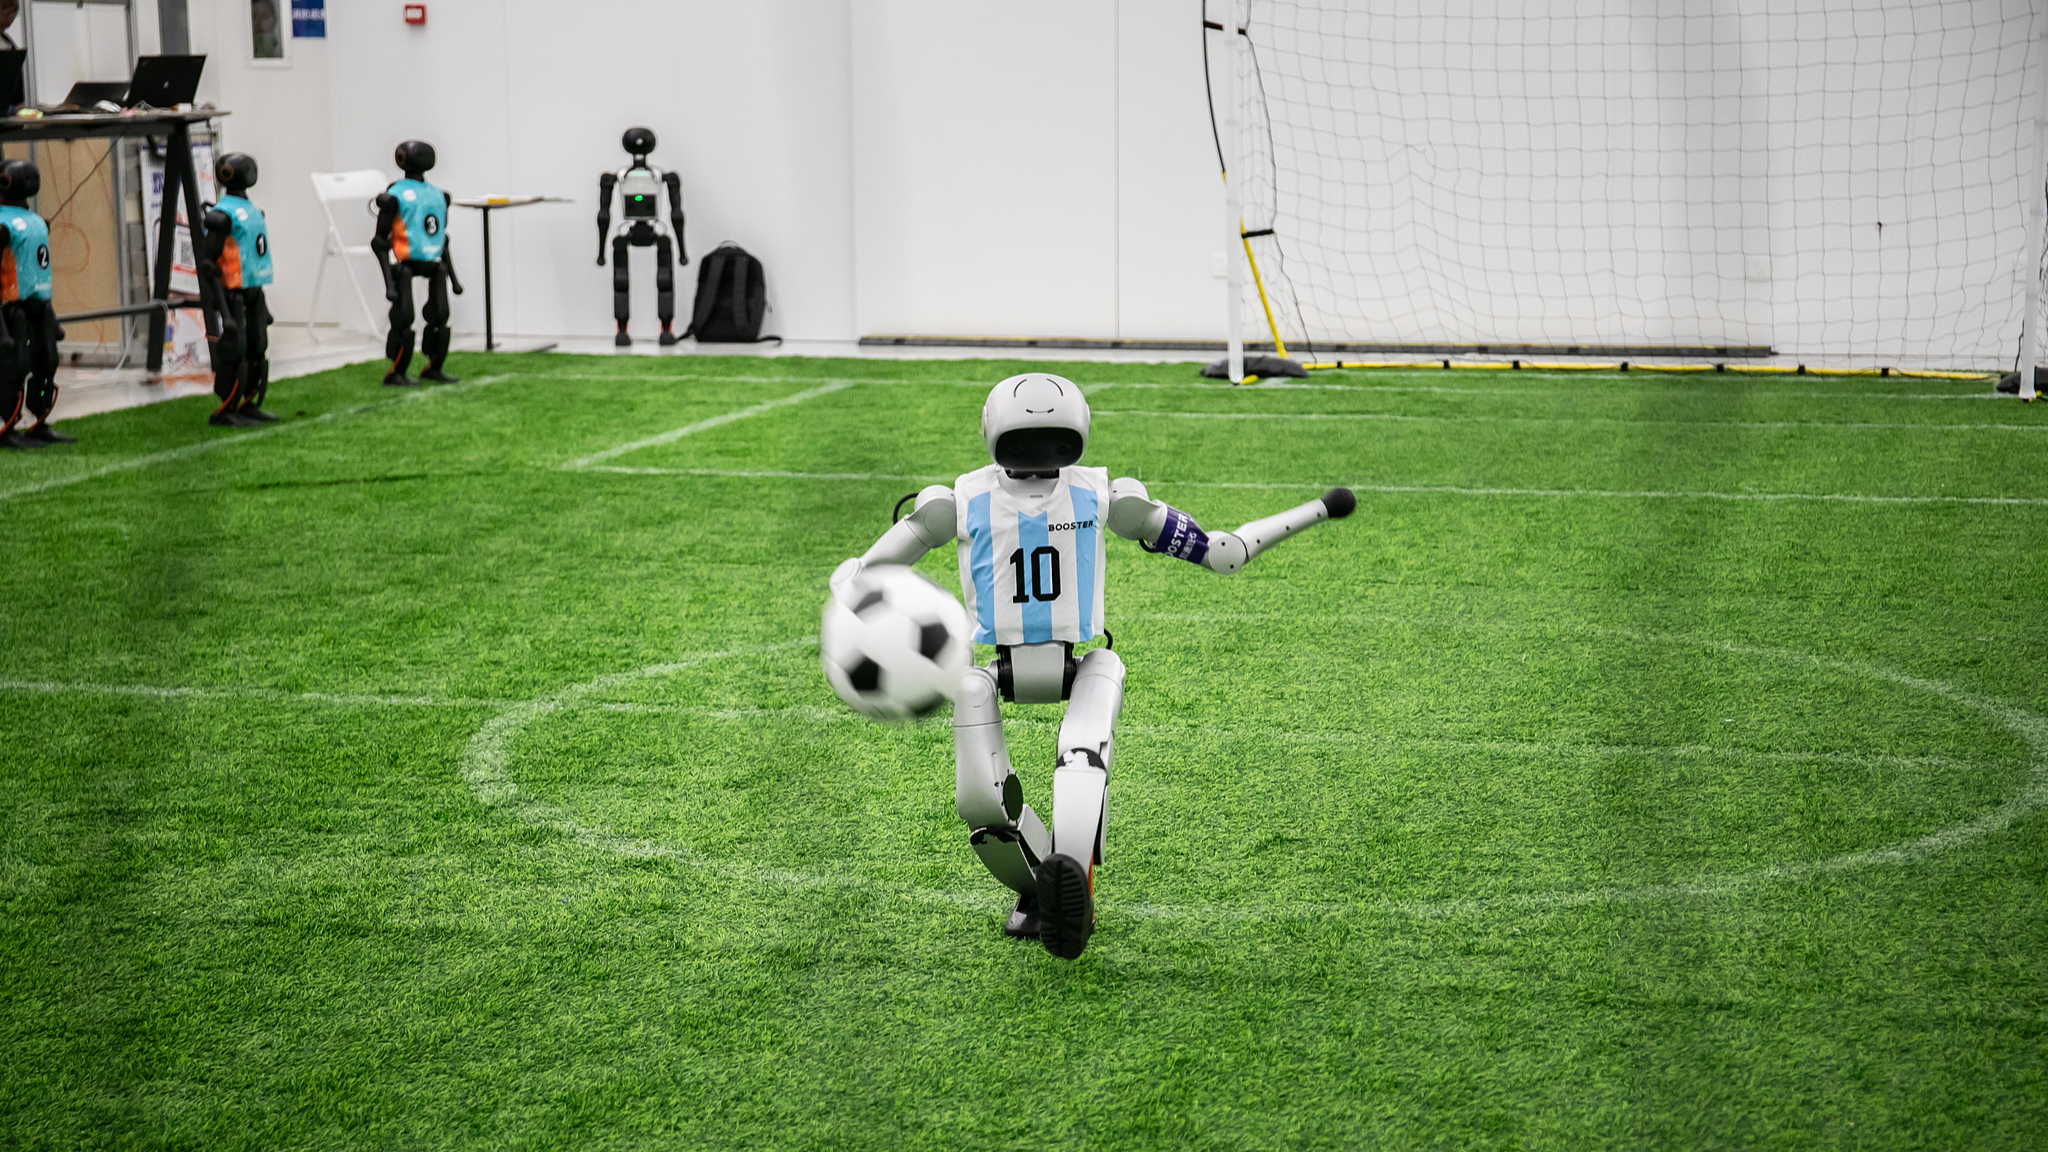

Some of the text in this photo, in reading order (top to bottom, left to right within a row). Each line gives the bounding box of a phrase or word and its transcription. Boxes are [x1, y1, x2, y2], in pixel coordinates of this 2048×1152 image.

[426, 215, 437, 234] 3
[258, 234, 265, 256] 1
[40, 246, 48, 268] 2
[1048, 520, 1094, 532] BOOSTER
[1165, 513, 1189, 557] OOSTER
[1009, 546, 1061, 604] 10
